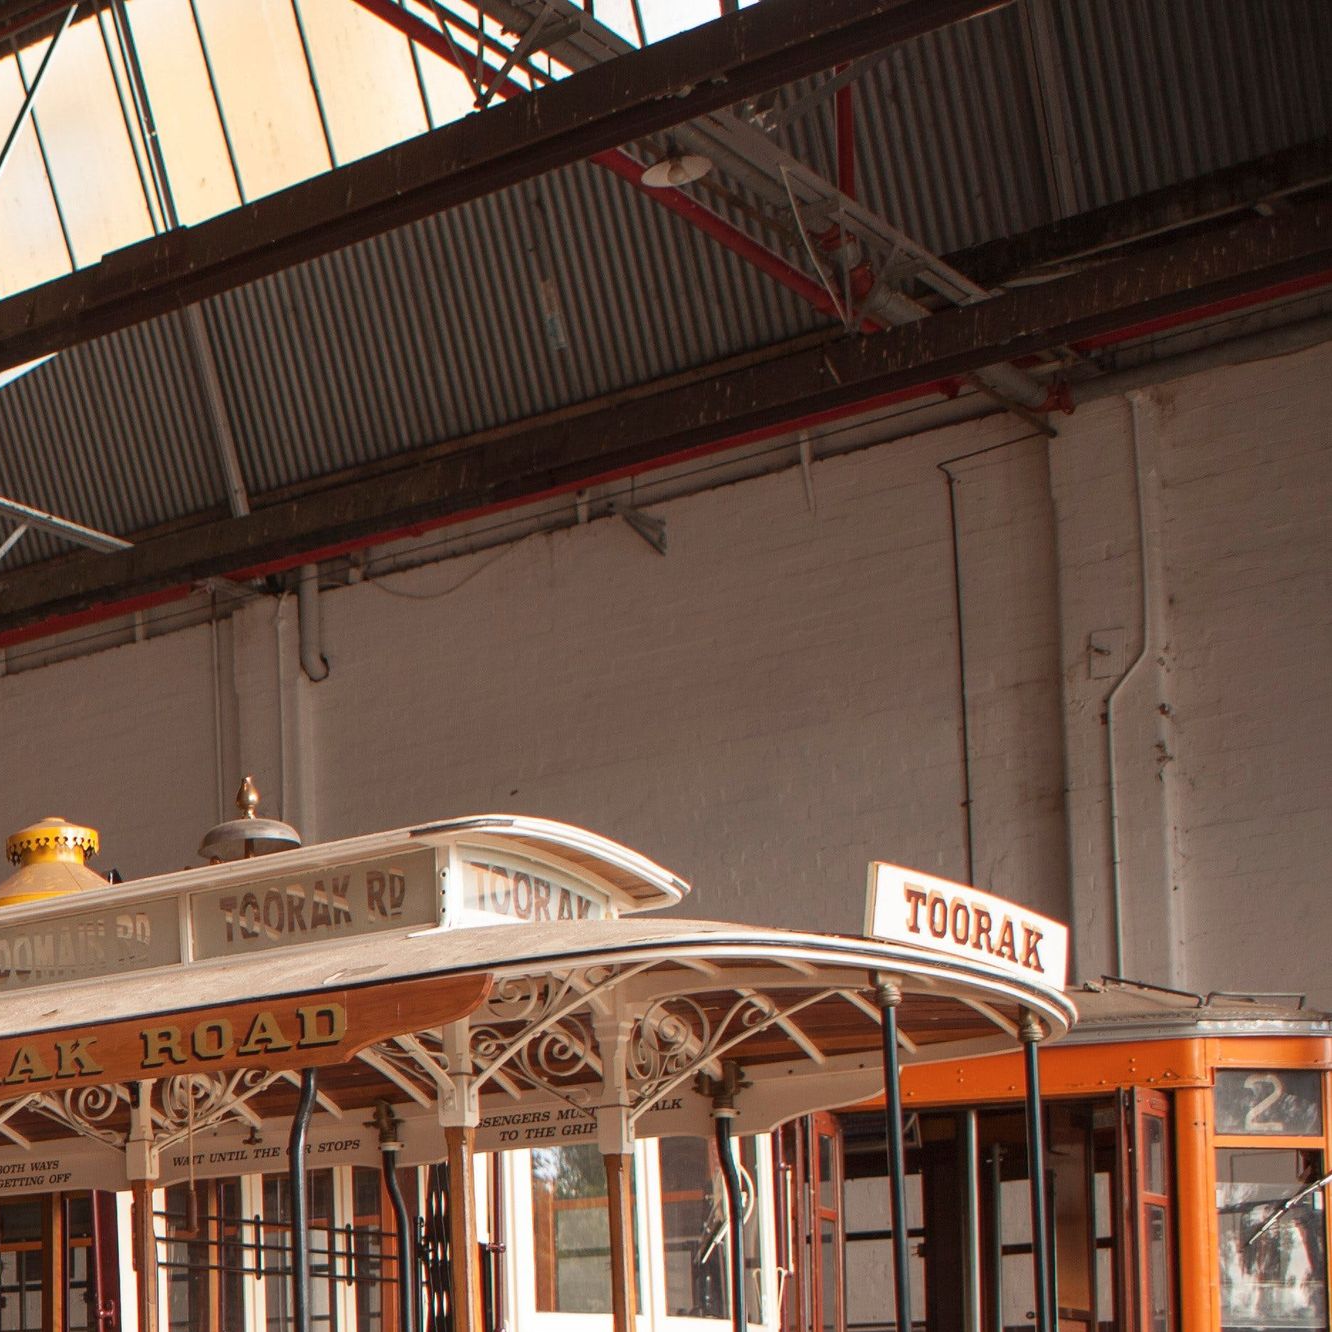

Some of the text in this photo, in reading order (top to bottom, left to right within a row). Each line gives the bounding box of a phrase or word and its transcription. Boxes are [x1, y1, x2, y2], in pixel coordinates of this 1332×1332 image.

[220, 874, 352, 942] TOORAK
[463, 861, 592, 920] TOORAK
[904, 884, 1044, 973] TOORAK
[140, 1002, 347, 1069] ROAD
[650, 1098, 682, 1112] ALK
[1243, 1072, 1284, 1131] 2
[209, 1150, 248, 1163] UNTIL
[253, 1146, 281, 1159] THE
[317, 1139, 360, 1153] STOPS
[499, 1129, 519, 1142] TO
[525, 1125, 557, 1139] THE
[30, 1159, 60, 1172] WAYS
[49, 1172, 72, 1184] OFF
